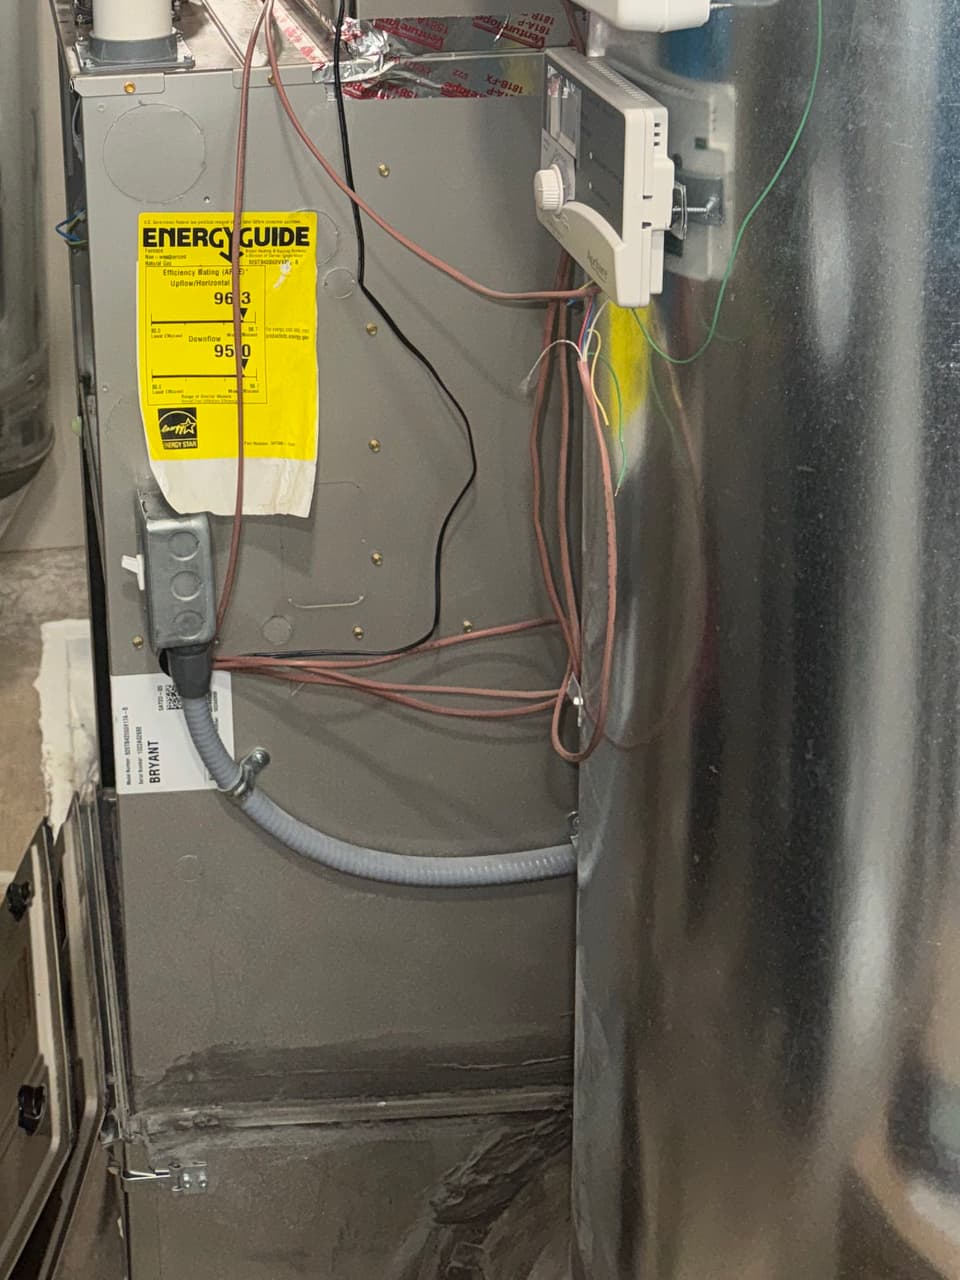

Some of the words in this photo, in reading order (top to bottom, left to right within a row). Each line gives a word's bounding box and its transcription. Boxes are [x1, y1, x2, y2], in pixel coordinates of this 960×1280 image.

[162, 268, 195, 277] Efficiency
[197, 268, 220, 277] Rating
[170, 278, 230, 287] Upflow/Horizontal
[214, 291, 251, 305] 963
[188, 335, 221, 343] Downflow
[214, 344, 251, 358] 950
[147, 740, 160, 784] BRYANT
